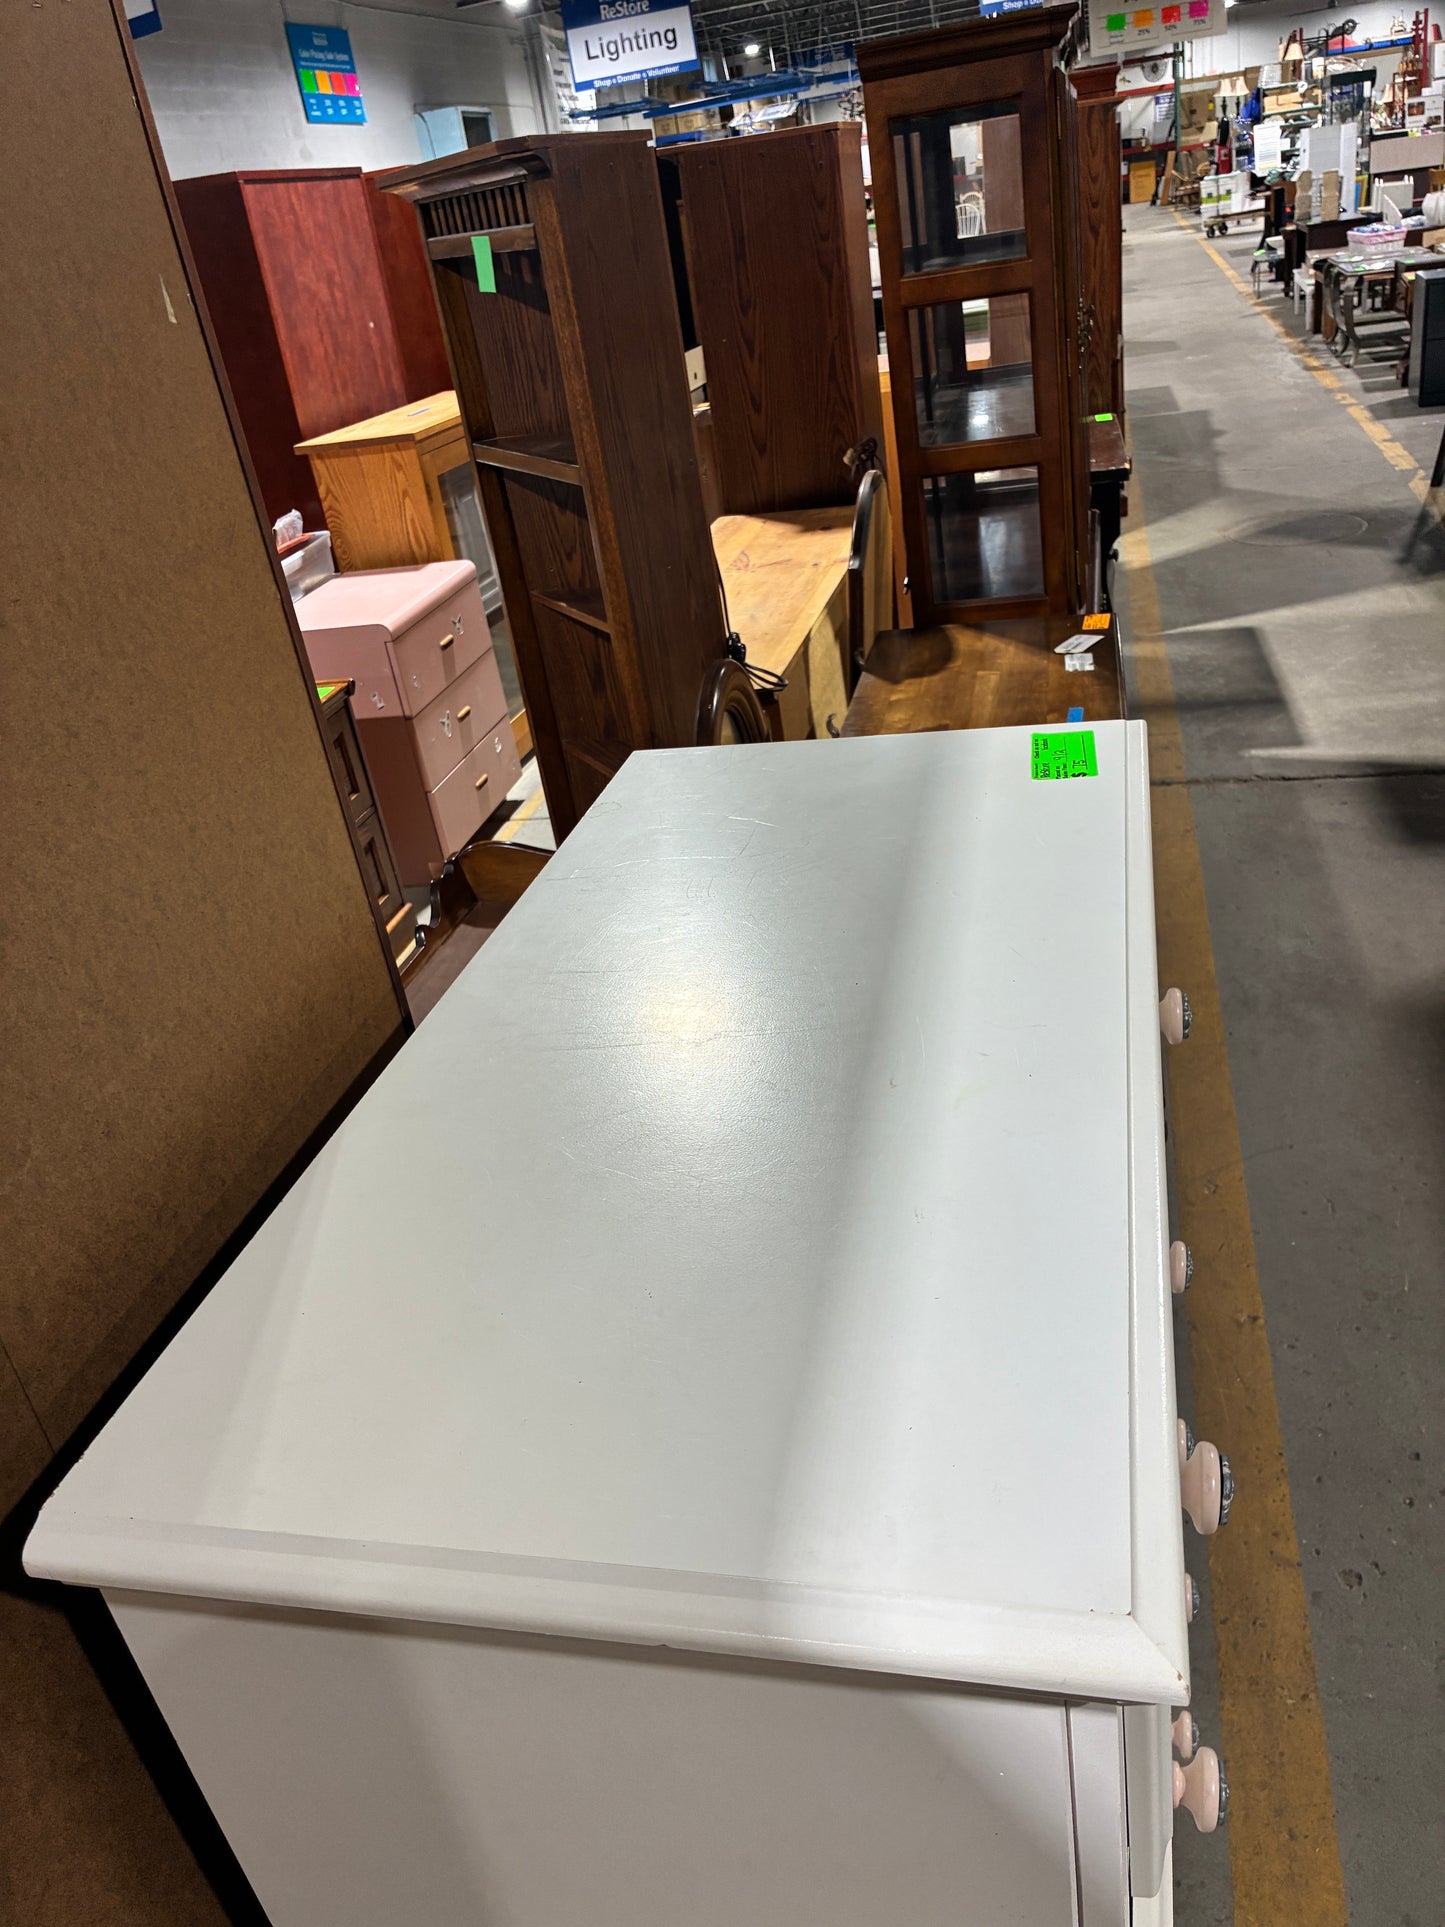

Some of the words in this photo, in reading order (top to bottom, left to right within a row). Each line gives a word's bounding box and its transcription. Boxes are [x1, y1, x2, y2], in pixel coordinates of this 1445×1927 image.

[600, 0, 650, 20] ReStore
[584, 27, 677, 61] Lighting
[593, 79, 612, 88] Shop
[616, 73, 641, 83] Donate
[646, 65, 680, 77] Volunteer
